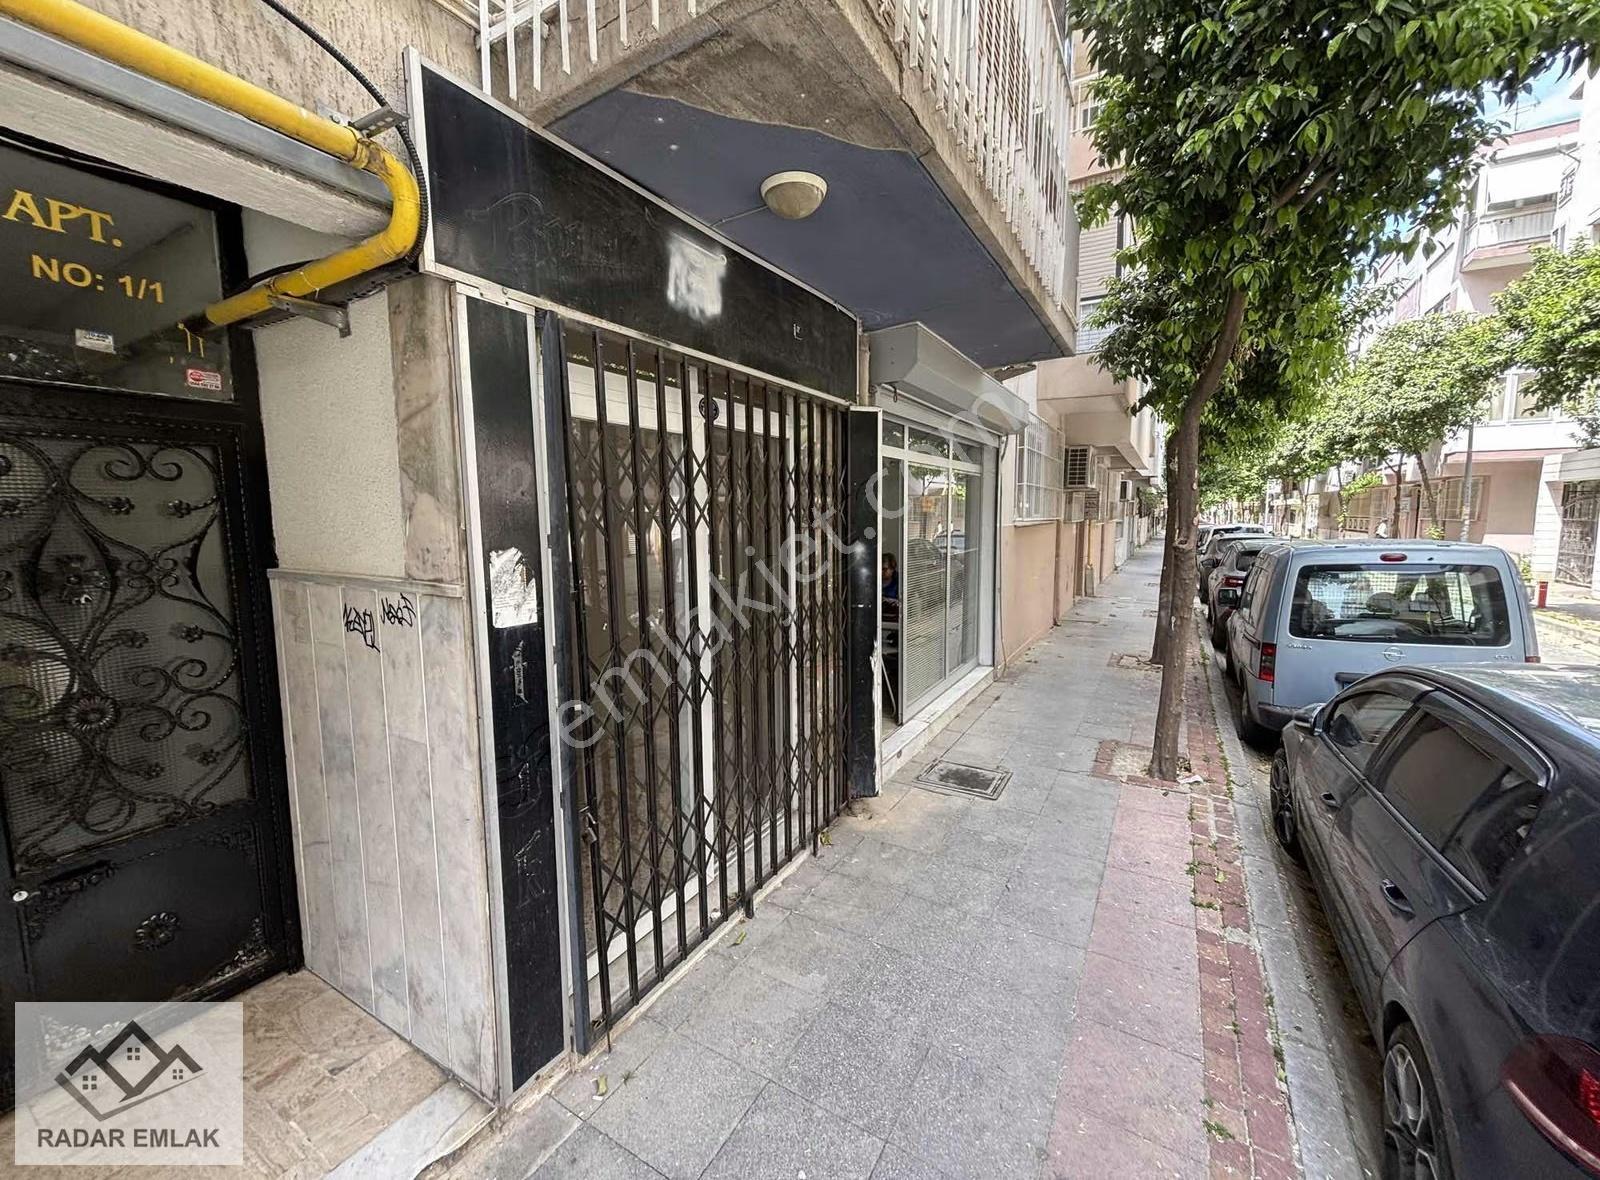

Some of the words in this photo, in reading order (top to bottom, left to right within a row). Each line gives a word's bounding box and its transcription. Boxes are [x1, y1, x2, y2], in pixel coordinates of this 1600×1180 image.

[2, 189, 122, 247] APT.
[31, 254, 104, 291] NO:
[118, 275, 164, 303] 1/1
